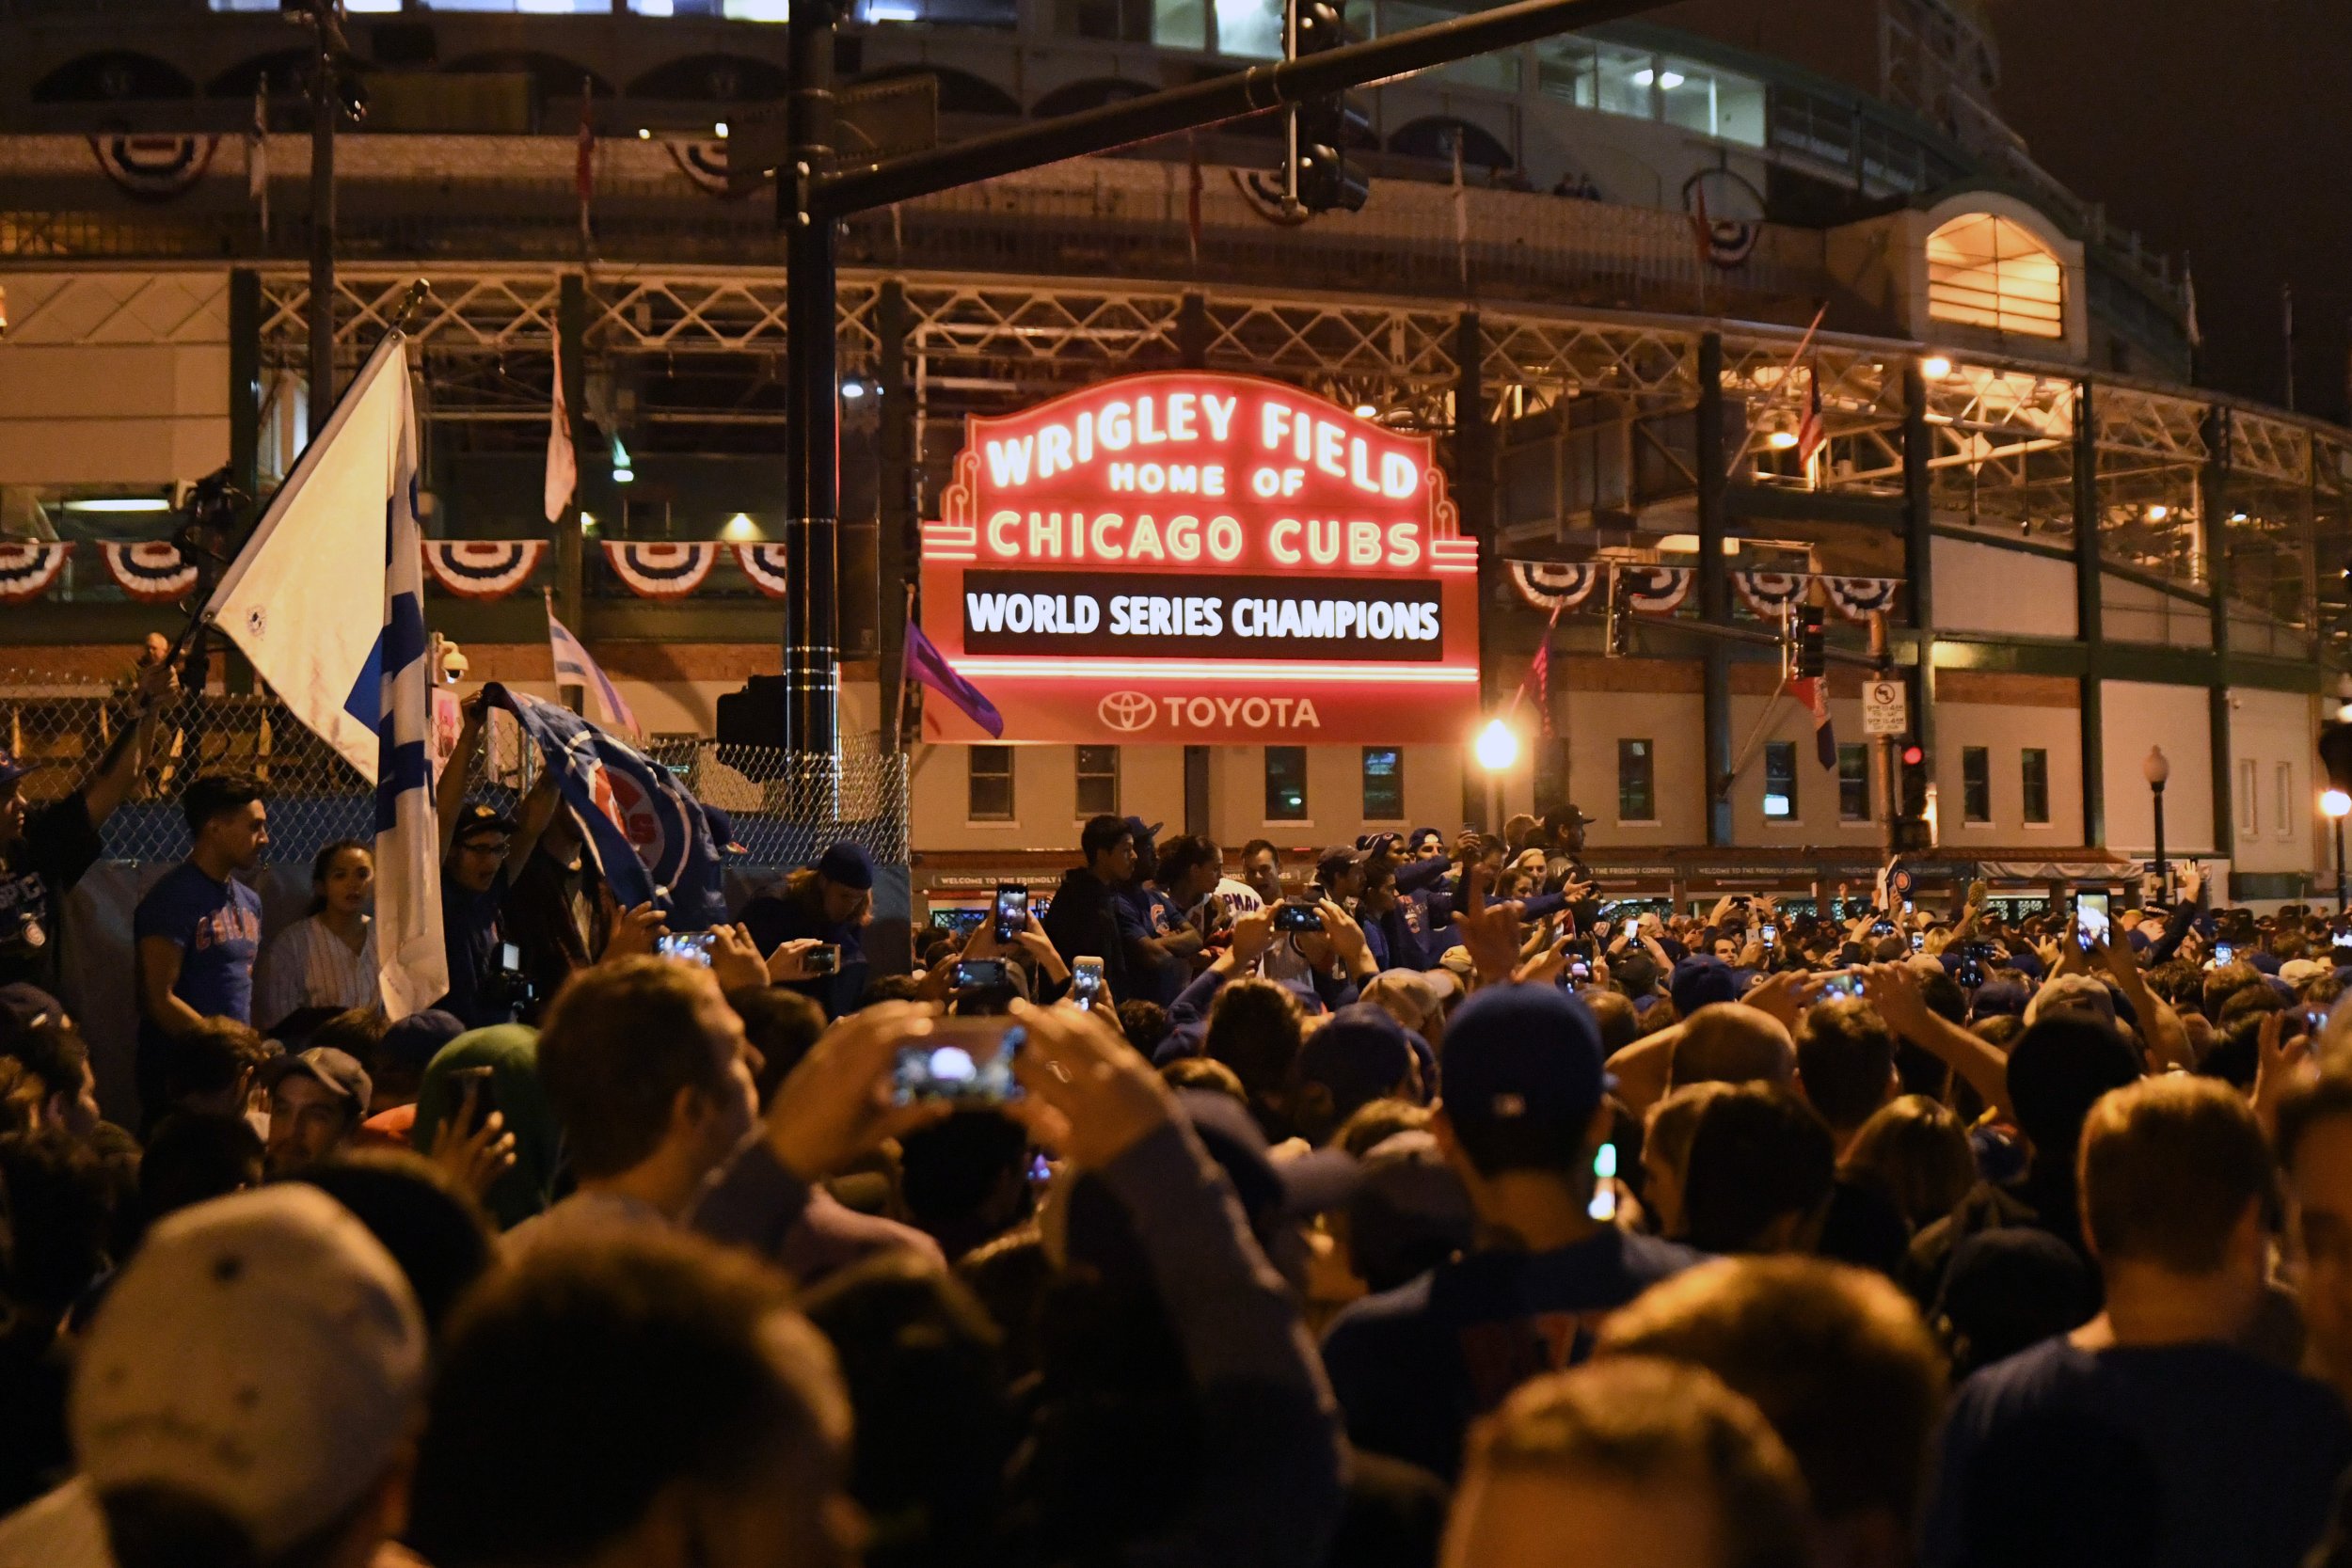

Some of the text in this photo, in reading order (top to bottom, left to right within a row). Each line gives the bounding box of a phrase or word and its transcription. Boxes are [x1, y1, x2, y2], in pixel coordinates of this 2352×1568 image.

[986, 393, 1418, 499] WRIGLEY FIELD
[1109, 463, 1305, 497] HOME OF
[988, 511, 1421, 566] CHICAGO CUBS
[967, 593, 1439, 641] WORLD SERIES CHAMPIONS
[1163, 696, 1321, 727] TOYOTA
[941, 877, 982, 885] WELCOME
[985, 877, 996, 885] TO
[998, 877, 1015, 885] THE
[1016, 876, 1057, 885] FRIENDLY
